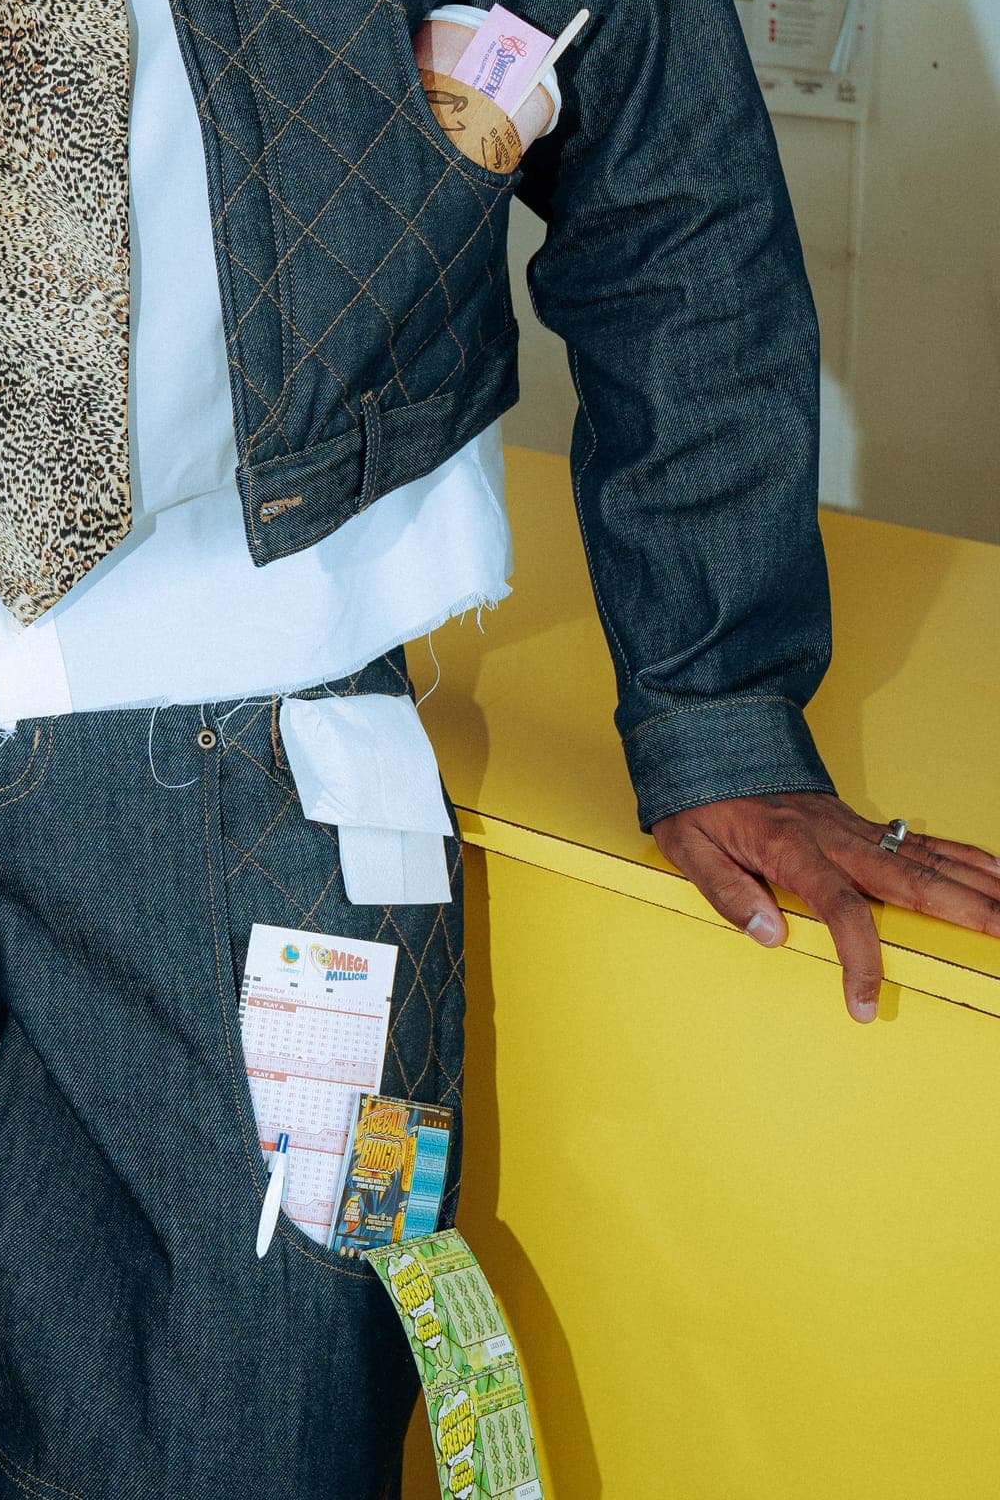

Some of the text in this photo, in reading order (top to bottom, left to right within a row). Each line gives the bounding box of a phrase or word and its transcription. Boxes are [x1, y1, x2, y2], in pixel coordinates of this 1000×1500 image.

[504, 128, 517, 149] HOT
[325, 970, 369, 981] MILLIONS
[327, 949, 369, 973] MEGA
[359, 1109, 409, 1140] FIREBALL
[359, 1139, 402, 1173] BINGO
[399, 1274, 434, 1316] FRENZY
[437, 1415, 476, 1466] FRENZY
